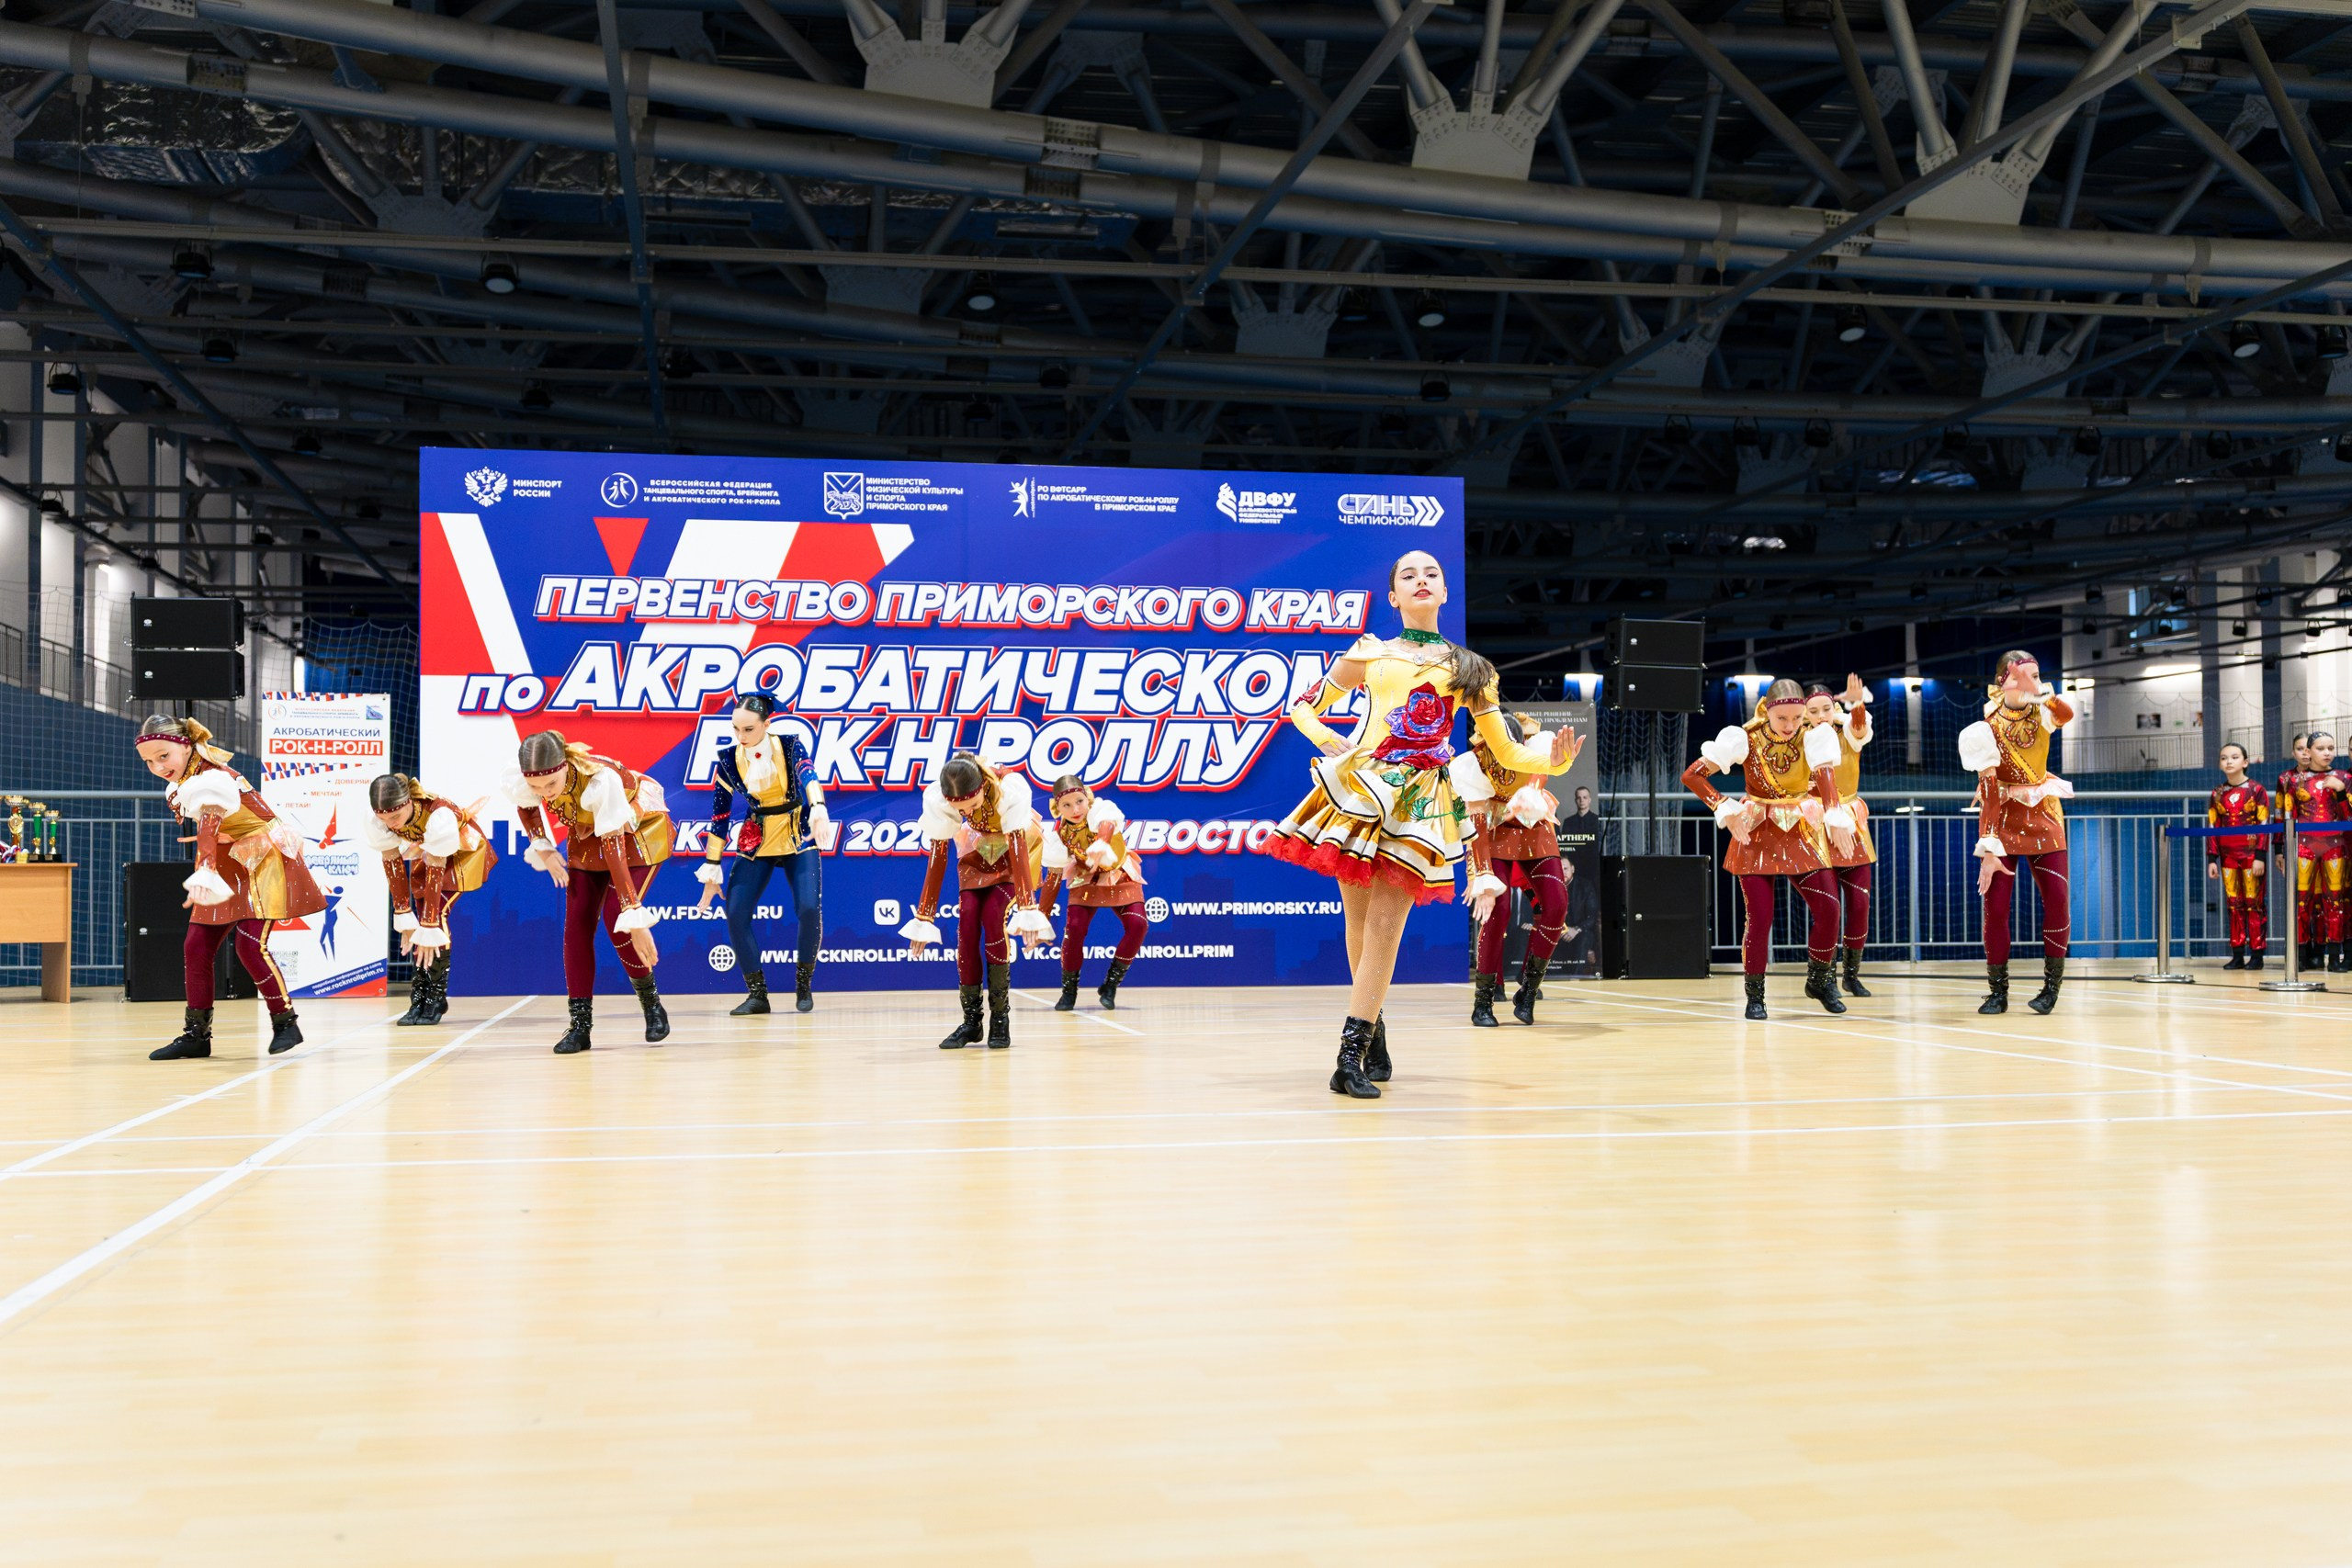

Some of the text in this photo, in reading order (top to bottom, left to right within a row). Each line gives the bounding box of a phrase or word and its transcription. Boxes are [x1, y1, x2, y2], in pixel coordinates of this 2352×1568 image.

[513, 479, 562, 489] МИНСПОРТ
[650, 479, 721, 488] ВСЕРОССИЙСКАЯ
[865, 477, 931, 486] МИНИСТЕРСТВО
[513, 489, 551, 498] РОССИИ
[643, 487, 705, 495] ТАНЦЕВАЛЬНОГО
[737, 489, 779, 497] БРЕЙКИНГА
[865, 486, 964, 495] ФИЗИЧЕСКОЙ КУЛЬТУРЫ
[1050, 494, 1128, 502] АКРОБАТИЧЕСКОМУ
[1238, 491, 1296, 507] ДВФУ
[865, 502, 948, 512] ПРИМОРСКОГО КРАЯ
[1102, 503, 1156, 512] ПРИМОРСКОМ
[1338, 493, 1415, 515] СТАНЬ
[1339, 515, 1415, 525] ЧЕМПИОНОМ
[533, 574, 1367, 632] ПЕРВЕНСТВО ПРИМОРСКОГО КРАЯ
[544, 640, 1366, 723] АКРОБАТИЧЕСКОМ
[273, 727, 380, 737] АКРОБАТИЧЕСКИЙ
[272, 739, 380, 755] РОК-Н-РОЛЛ
[684, 714, 1281, 792] РК-НРОЛЛУ
[1172, 902, 1342, 915] WWW.PRIMORSKY.RU
[314, 967, 384, 996] www.rocknrollprim.ru
